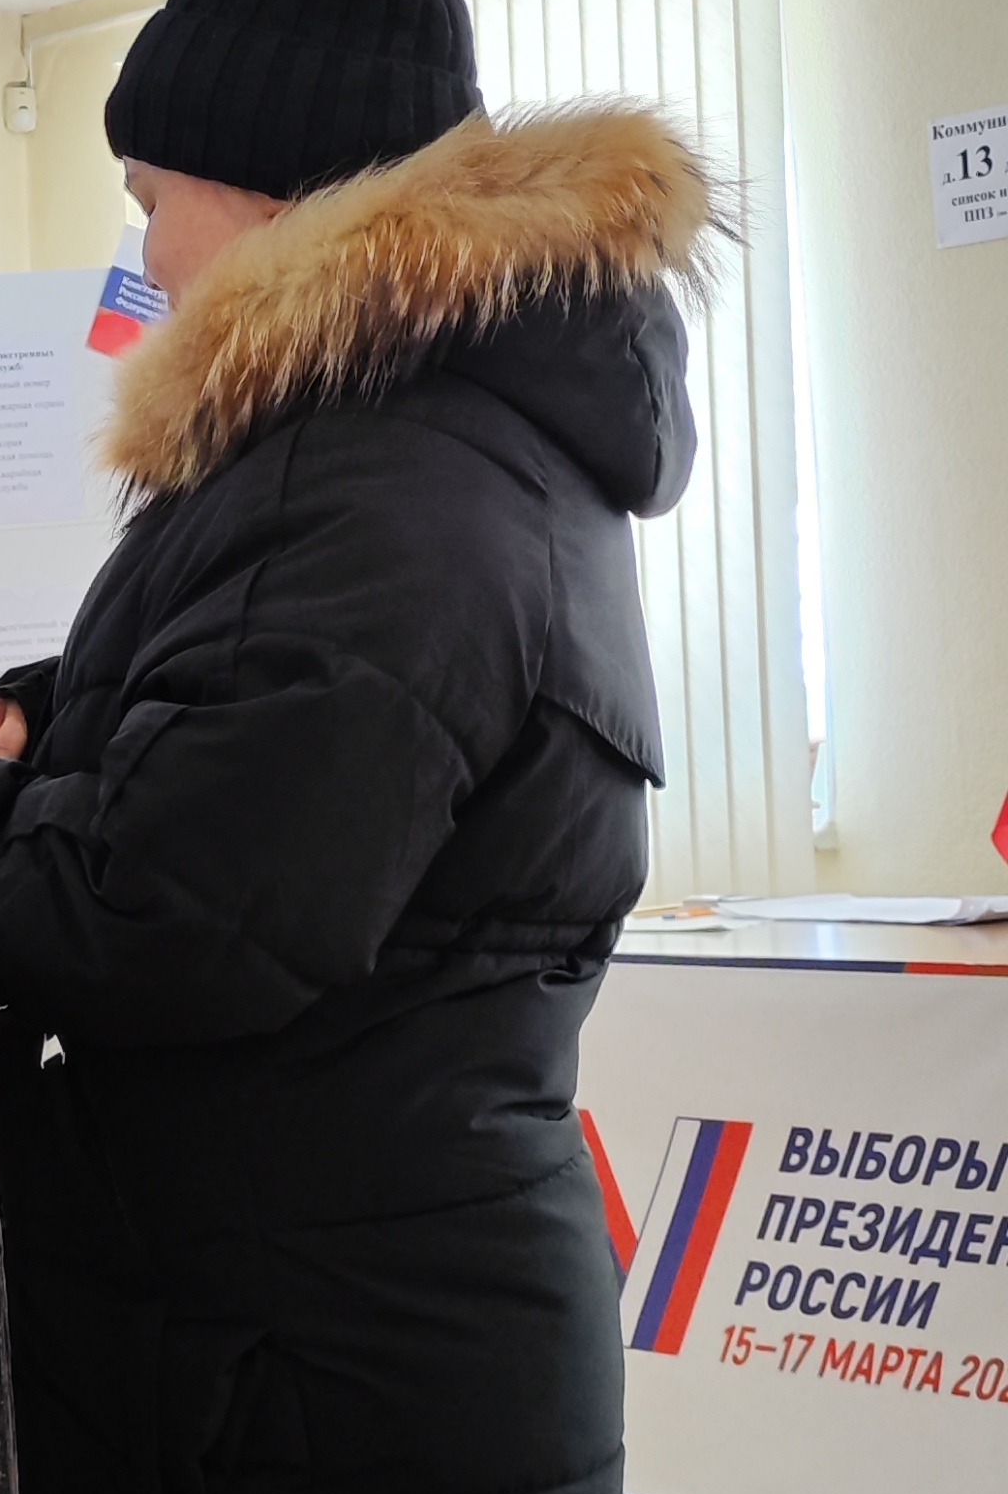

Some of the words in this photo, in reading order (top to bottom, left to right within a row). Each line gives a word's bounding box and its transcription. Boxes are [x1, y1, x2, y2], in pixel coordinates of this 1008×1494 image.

[952, 190, 996, 207] список
[779, 1126, 1008, 1192] ВЫБОРЫ
[734, 1260, 941, 1330] РОССИИ
[818, 1337, 943, 1394] МАРТА
